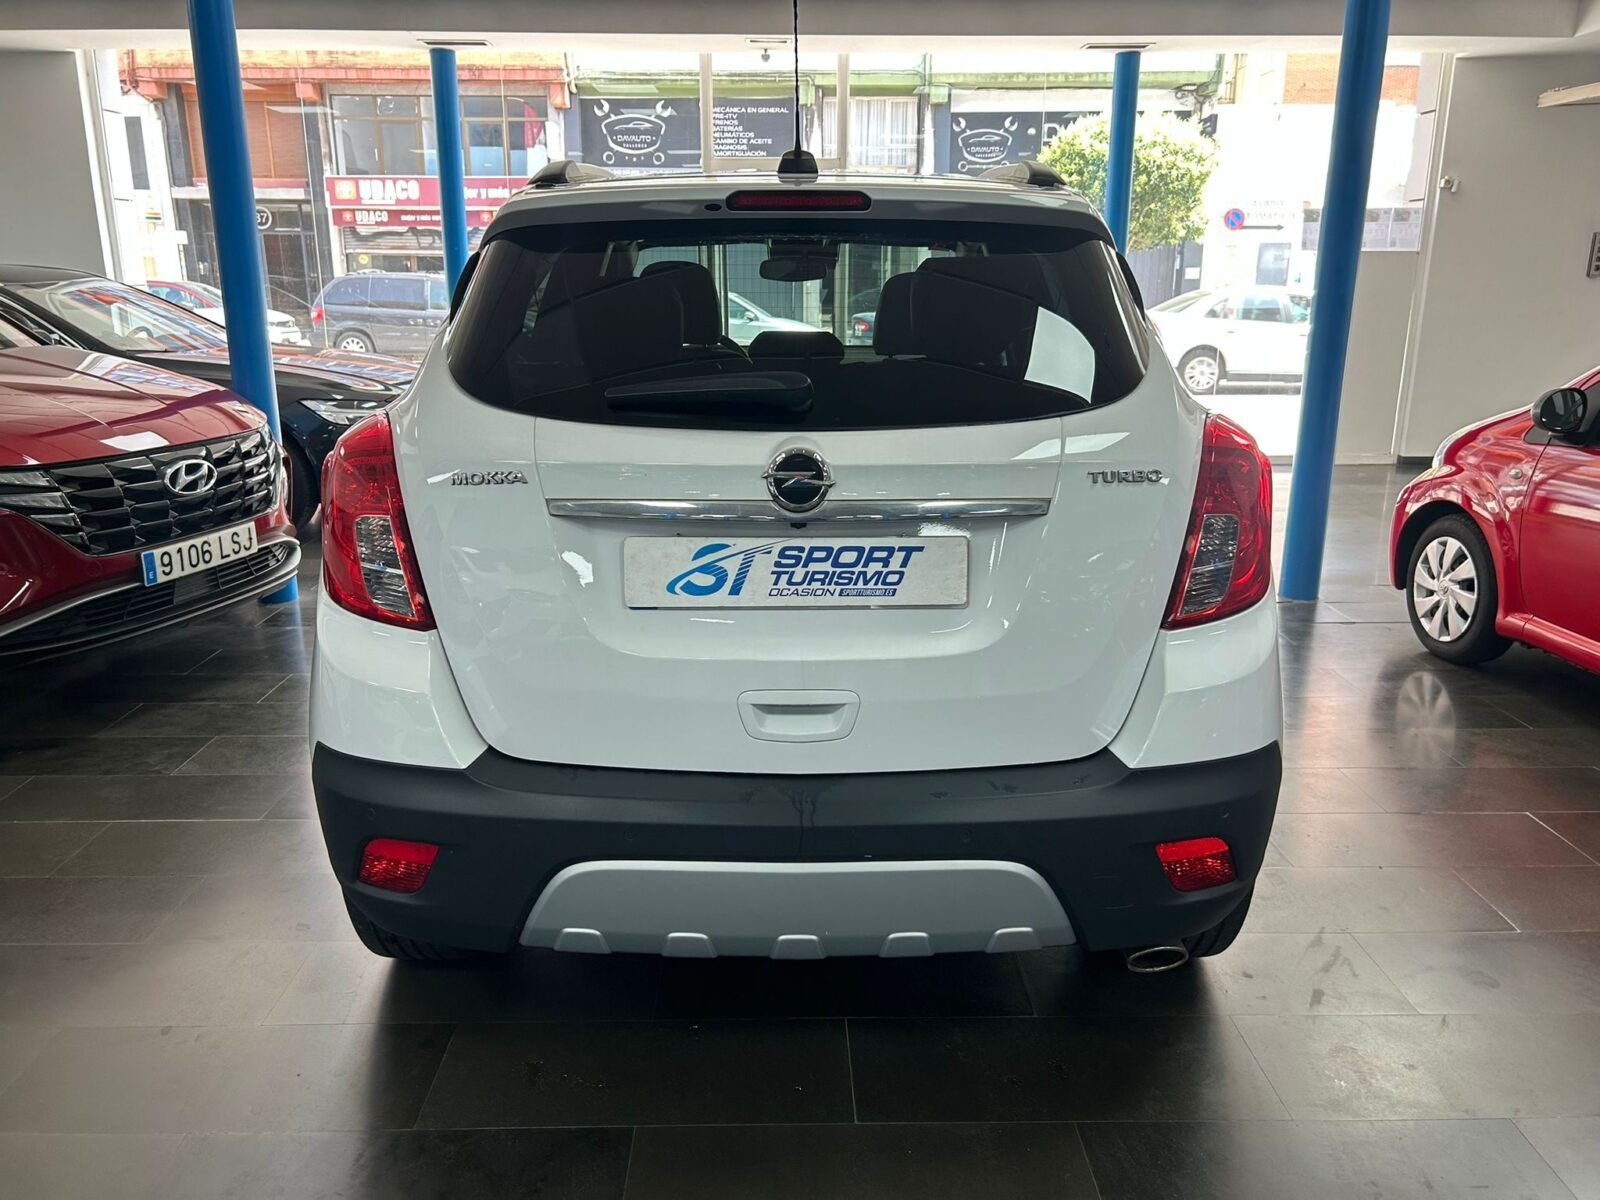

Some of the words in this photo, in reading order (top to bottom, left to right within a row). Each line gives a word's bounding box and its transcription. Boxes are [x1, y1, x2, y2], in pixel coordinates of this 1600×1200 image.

[617, 134, 651, 142] DAVAUTO
[358, 179, 420, 200] UDACO
[355, 210, 389, 222] UDACO
[451, 471, 528, 486] MOKKA
[1087, 470, 1162, 484] TURBO
[160, 540, 213, 576] 9106
[218, 527, 253, 560] LSJ
[773, 546, 925, 569] SPORT
[769, 570, 905, 587] TURISMO
[768, 588, 837, 597] OCASION
